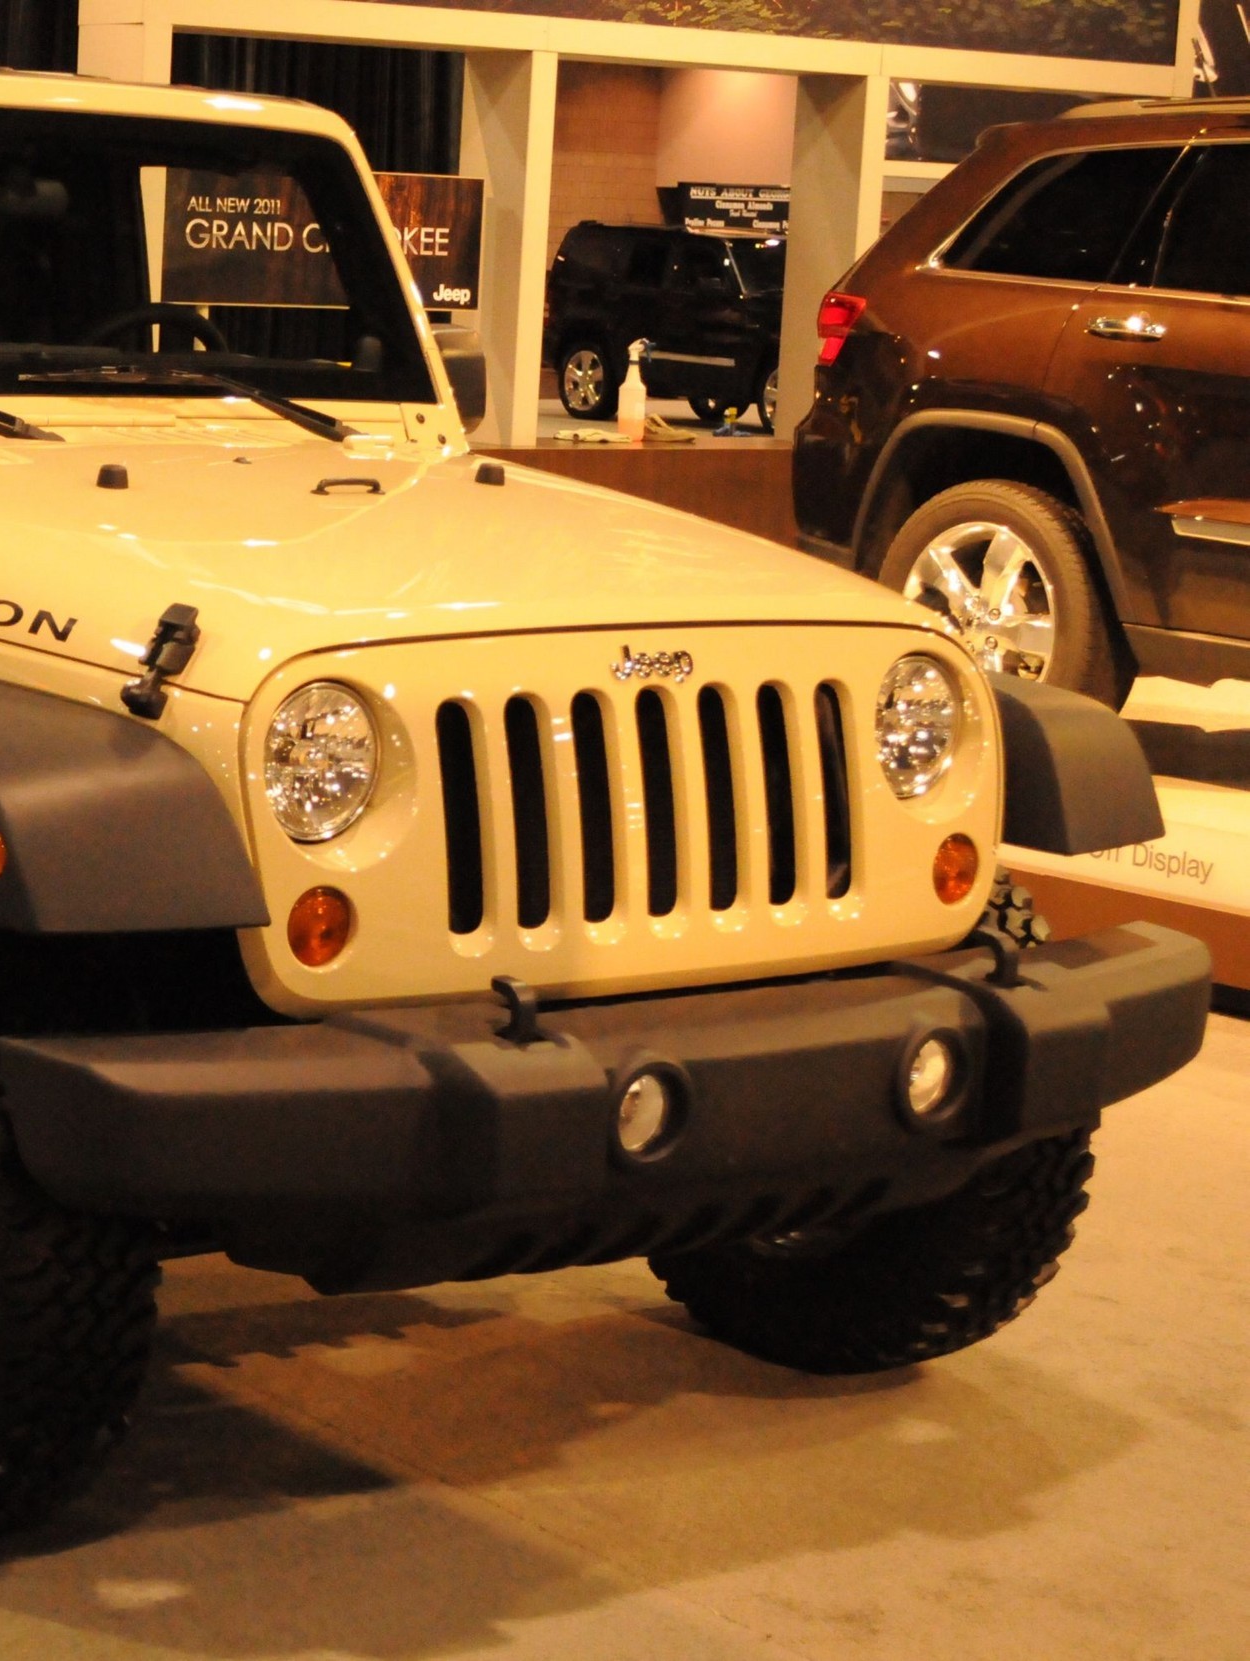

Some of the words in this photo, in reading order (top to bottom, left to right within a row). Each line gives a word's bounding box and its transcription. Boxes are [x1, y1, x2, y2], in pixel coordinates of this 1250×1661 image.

[187, 196, 212, 212] ALL
[216, 197, 250, 214] NEW
[253, 198, 281, 215] 2011
[690, 187, 716, 197] NUTS
[720, 188, 754, 198] ABOUT
[185, 218, 294, 251] GRAND
[433, 284, 471, 305] Jeep
[611, 645, 693, 683] Jeep
[1132, 843, 1214, 884] Display
